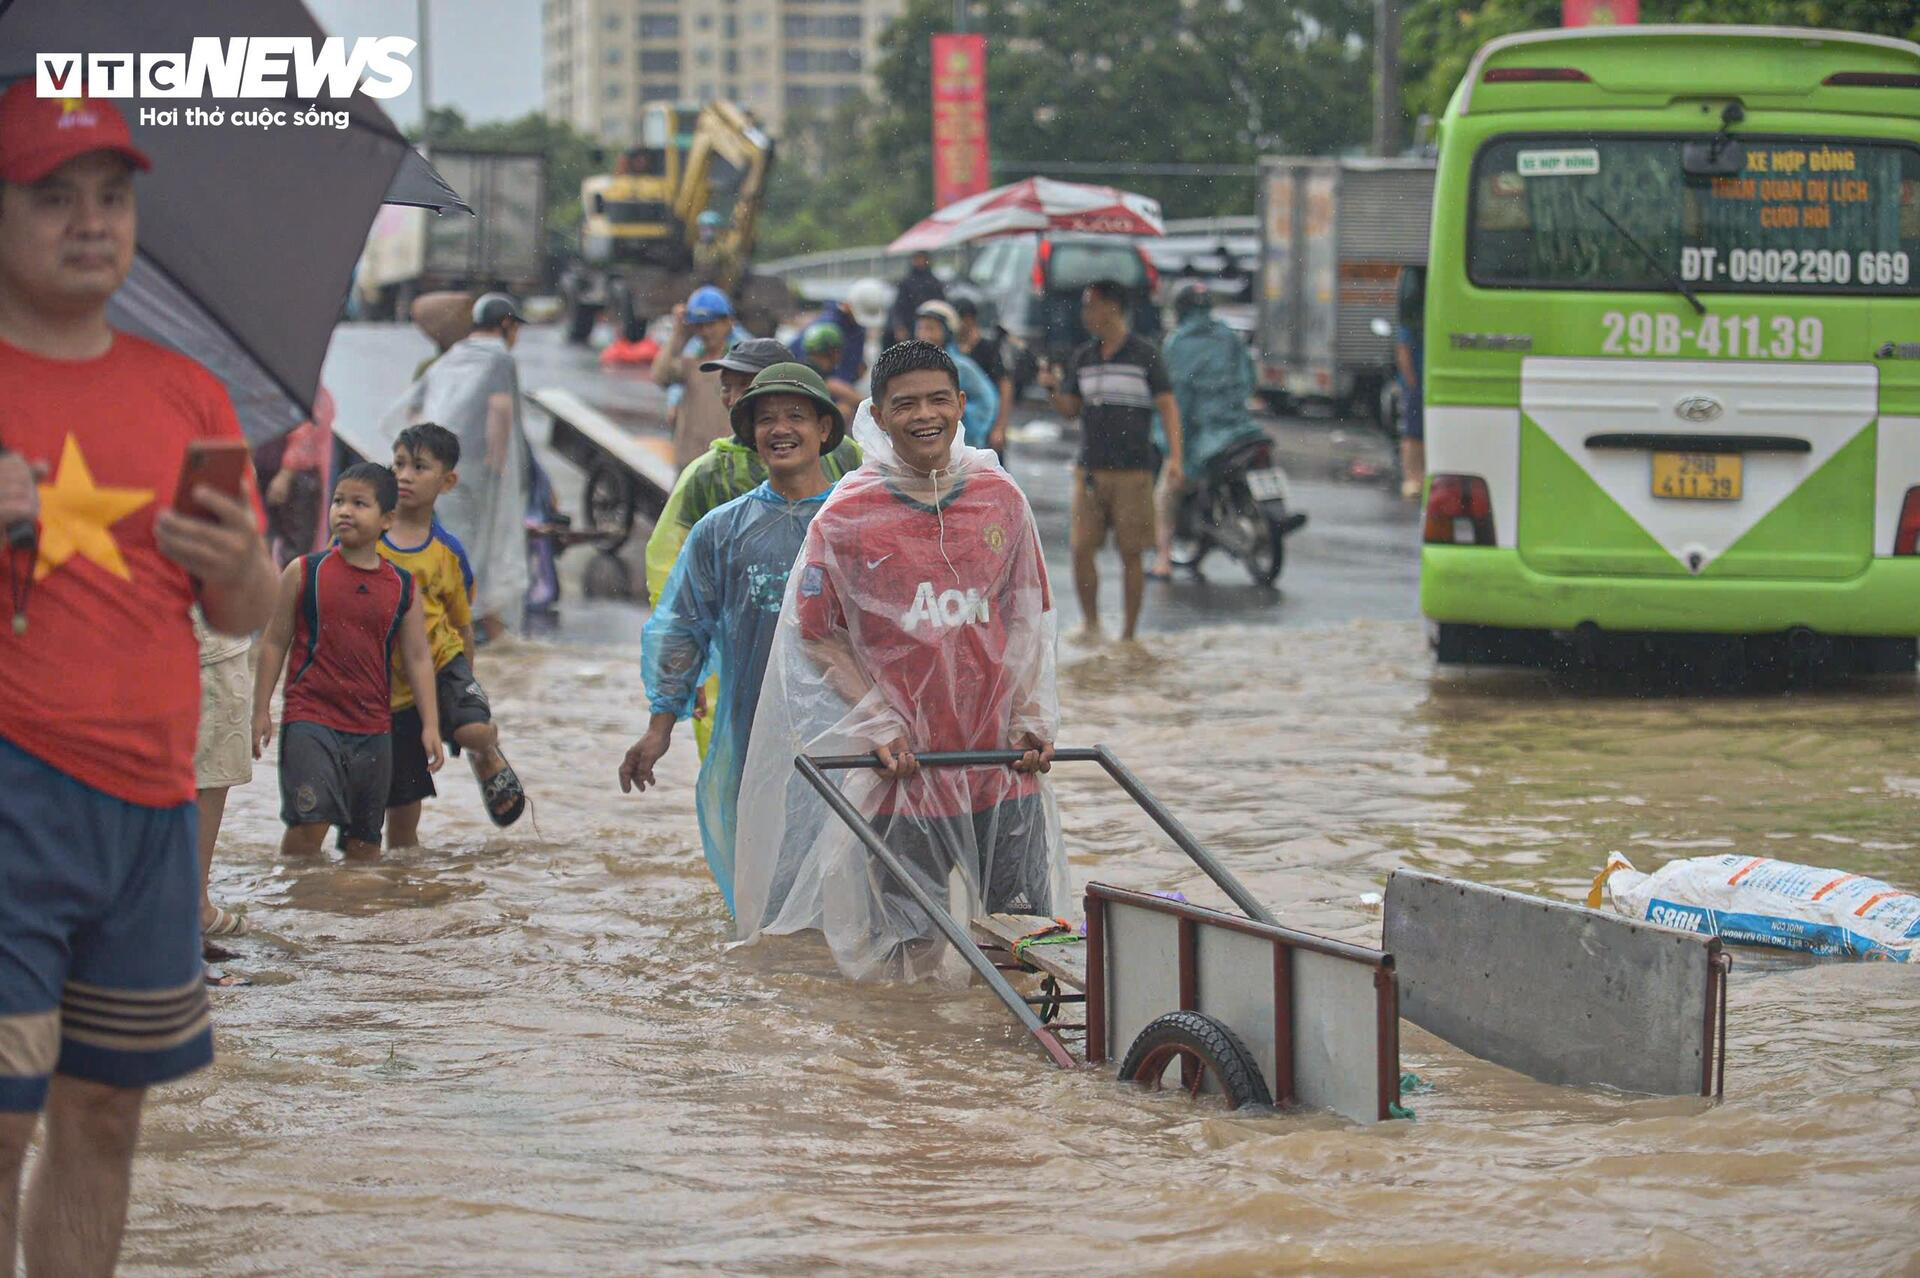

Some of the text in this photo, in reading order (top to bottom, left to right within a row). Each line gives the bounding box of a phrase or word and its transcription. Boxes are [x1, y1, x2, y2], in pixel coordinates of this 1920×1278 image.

[1746, 152, 1768, 172] XE
[1858, 251, 1910, 285] 669
[1602, 311, 1824, 359] 29B-411.39
